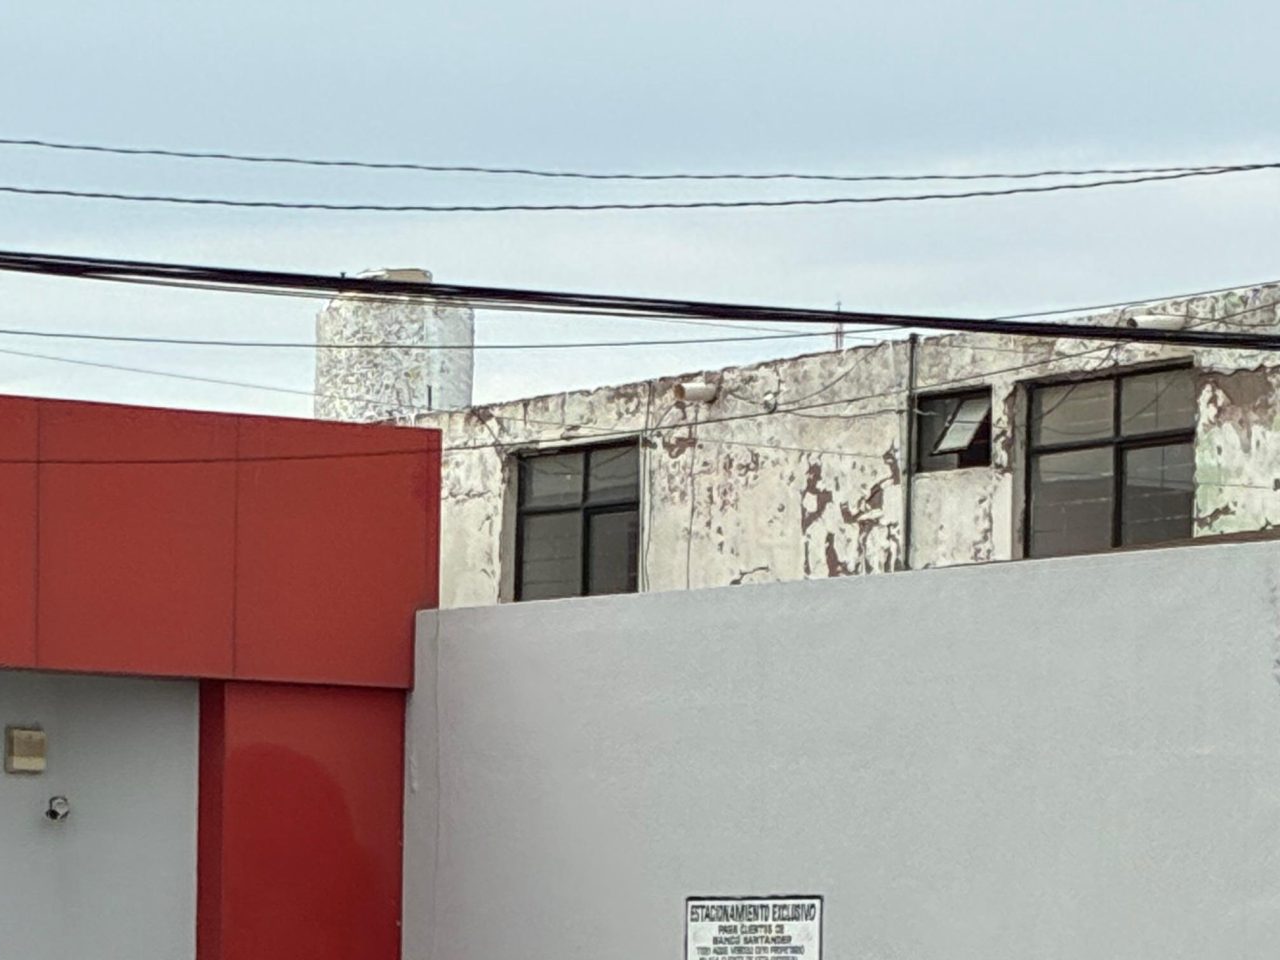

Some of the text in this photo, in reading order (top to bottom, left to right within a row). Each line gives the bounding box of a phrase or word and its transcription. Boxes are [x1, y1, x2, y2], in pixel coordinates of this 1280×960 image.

[690, 904, 816, 922] ESTACIONAMIENTO EXCLUSIVO
[718, 924, 784, 935] PARA CLIENTES DE
[712, 936, 792, 946] BANCO SANTANDER
